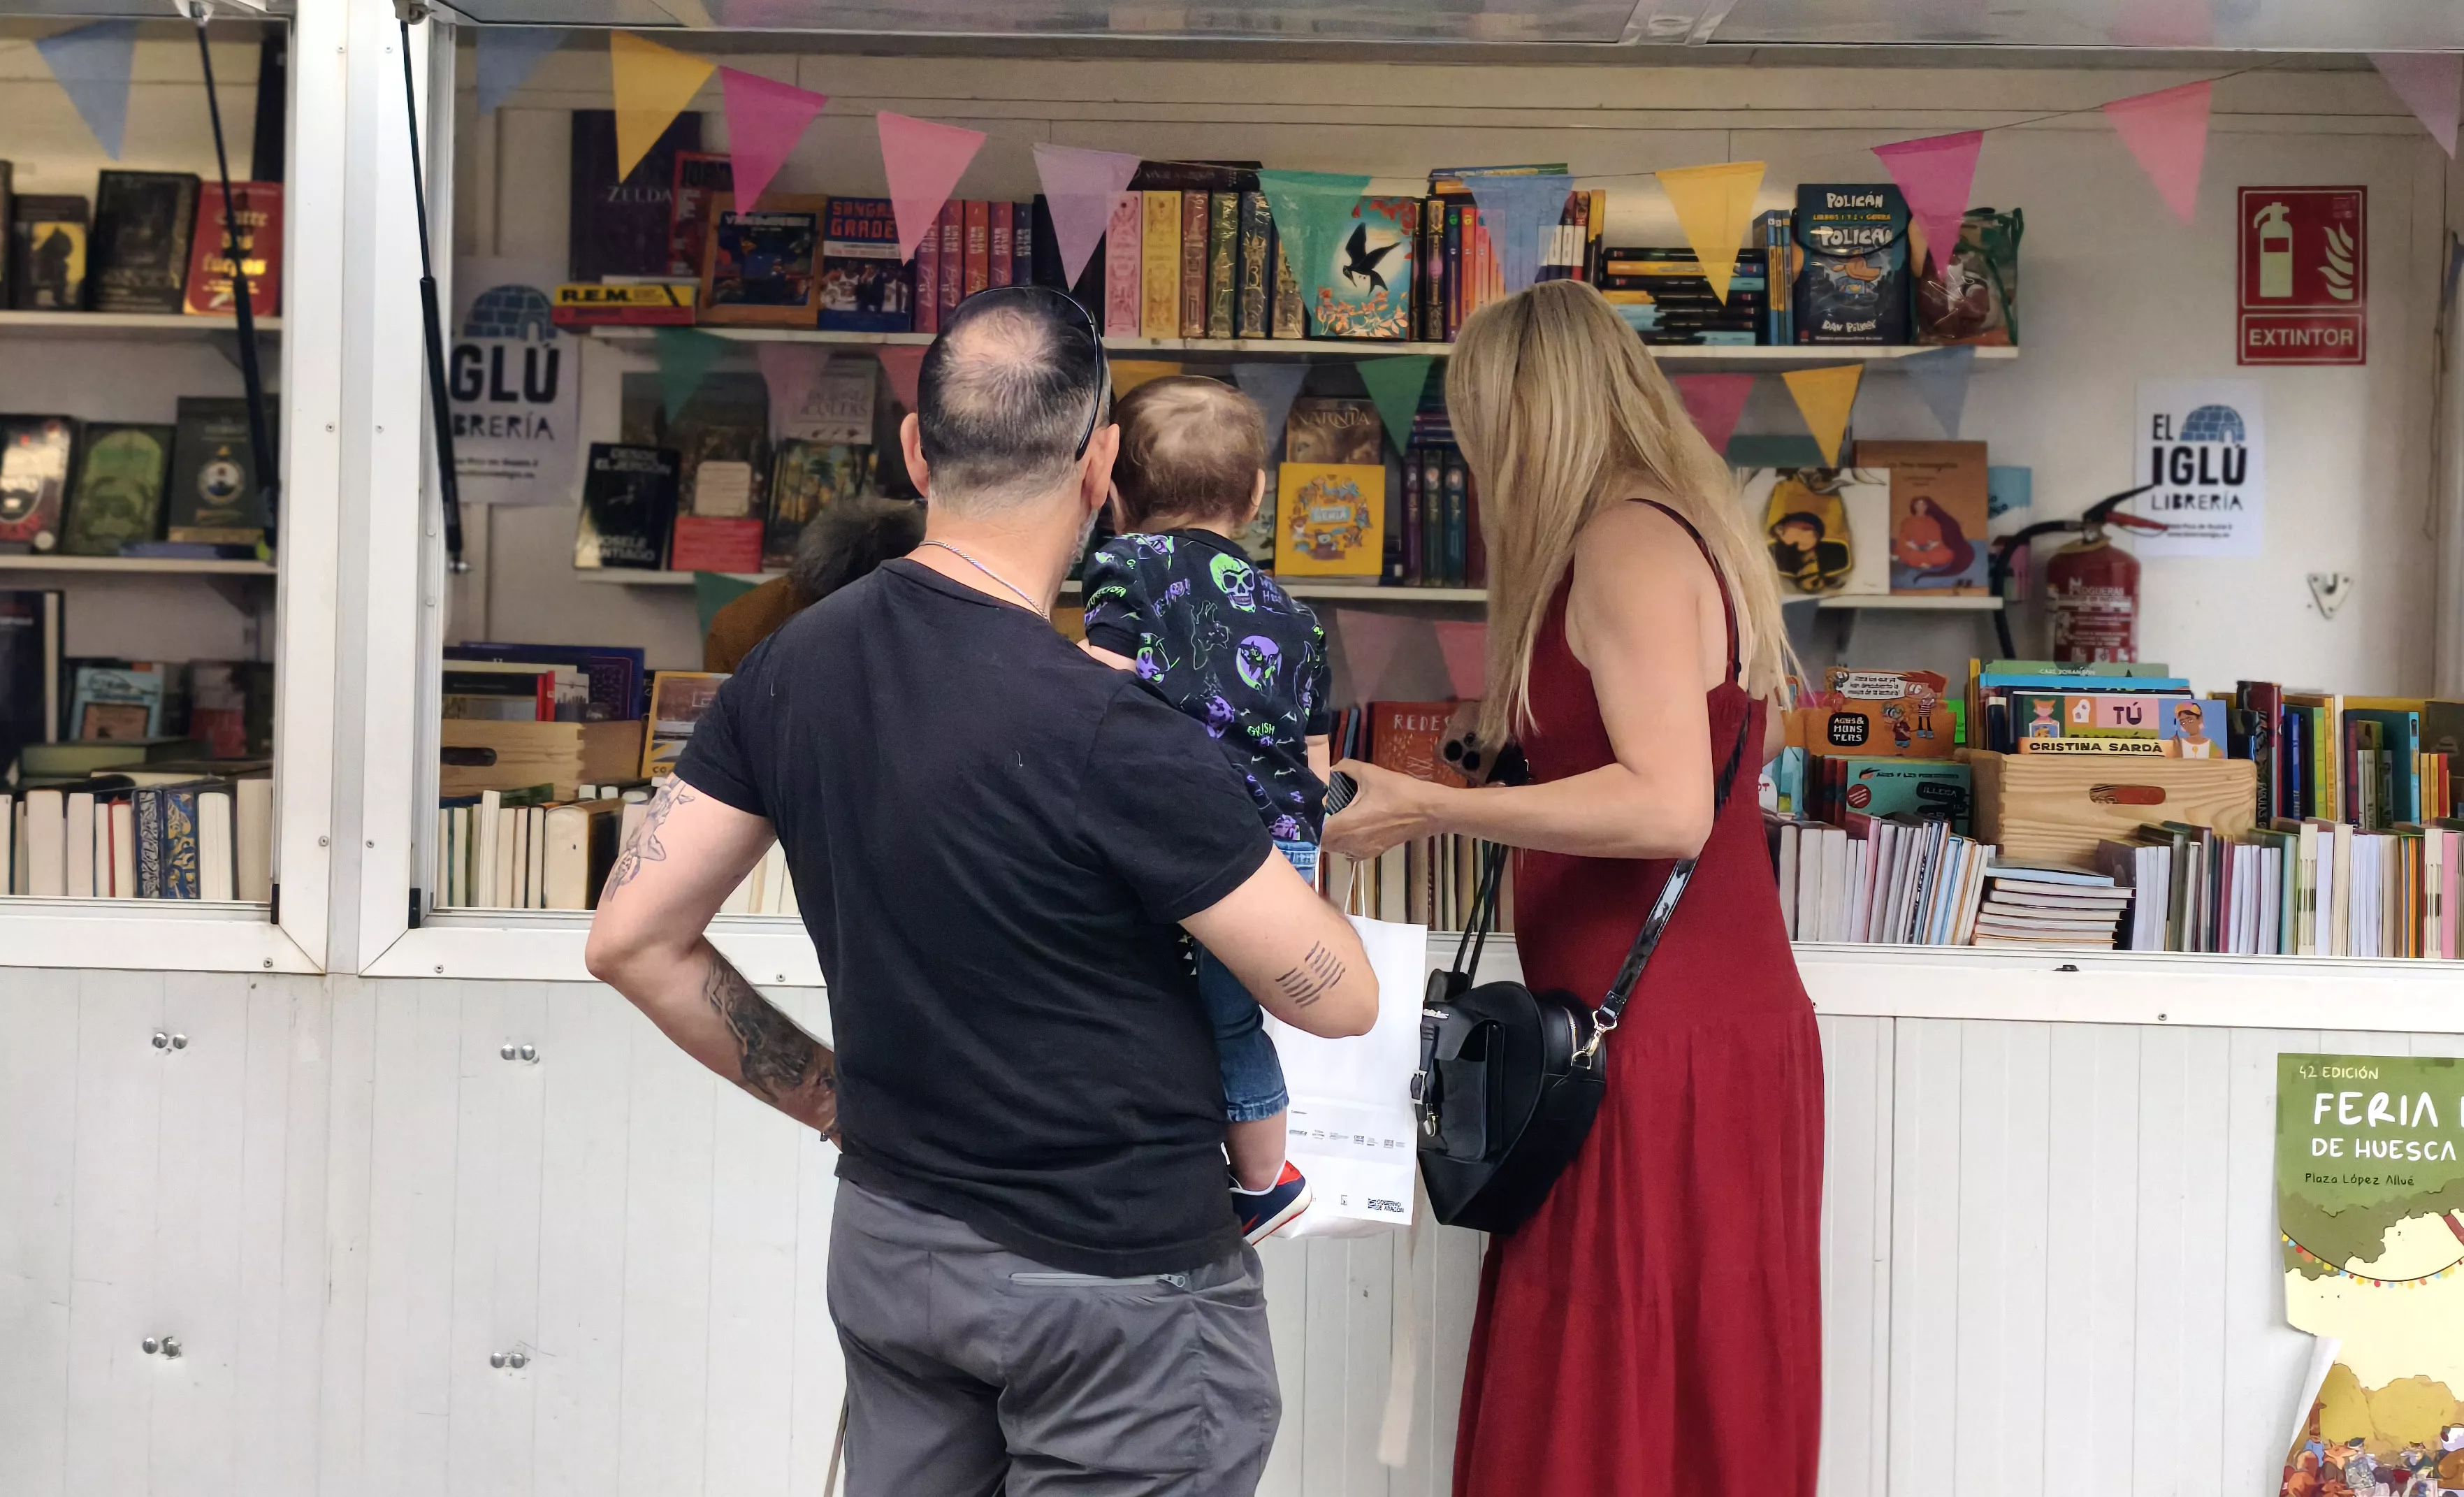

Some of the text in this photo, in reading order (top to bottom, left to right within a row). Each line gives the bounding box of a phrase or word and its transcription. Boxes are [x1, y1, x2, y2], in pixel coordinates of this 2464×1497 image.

[1826, 191, 1883, 208] POLICÁN
[2249, 328, 2354, 346] EXTINTOR
[451, 342, 560, 404] GLÚ
[453, 410, 554, 441] BRERÍA
[2152, 414, 2174, 442] EL
[2152, 444, 2247, 486] IGLÚ
[2151, 491, 2243, 512] LIBRERÍA
[2112, 702, 2143, 725] TÚ
[2029, 742, 2163, 753] CRISTINA SARDÀ
[2298, 1065, 2379, 1080] 42 EDICIÓN
[2314, 1091, 2439, 1128] FERIA
[2312, 1138, 2456, 1162] DE HUESCA
[2305, 1172, 2414, 1187] Plaza López Allué
